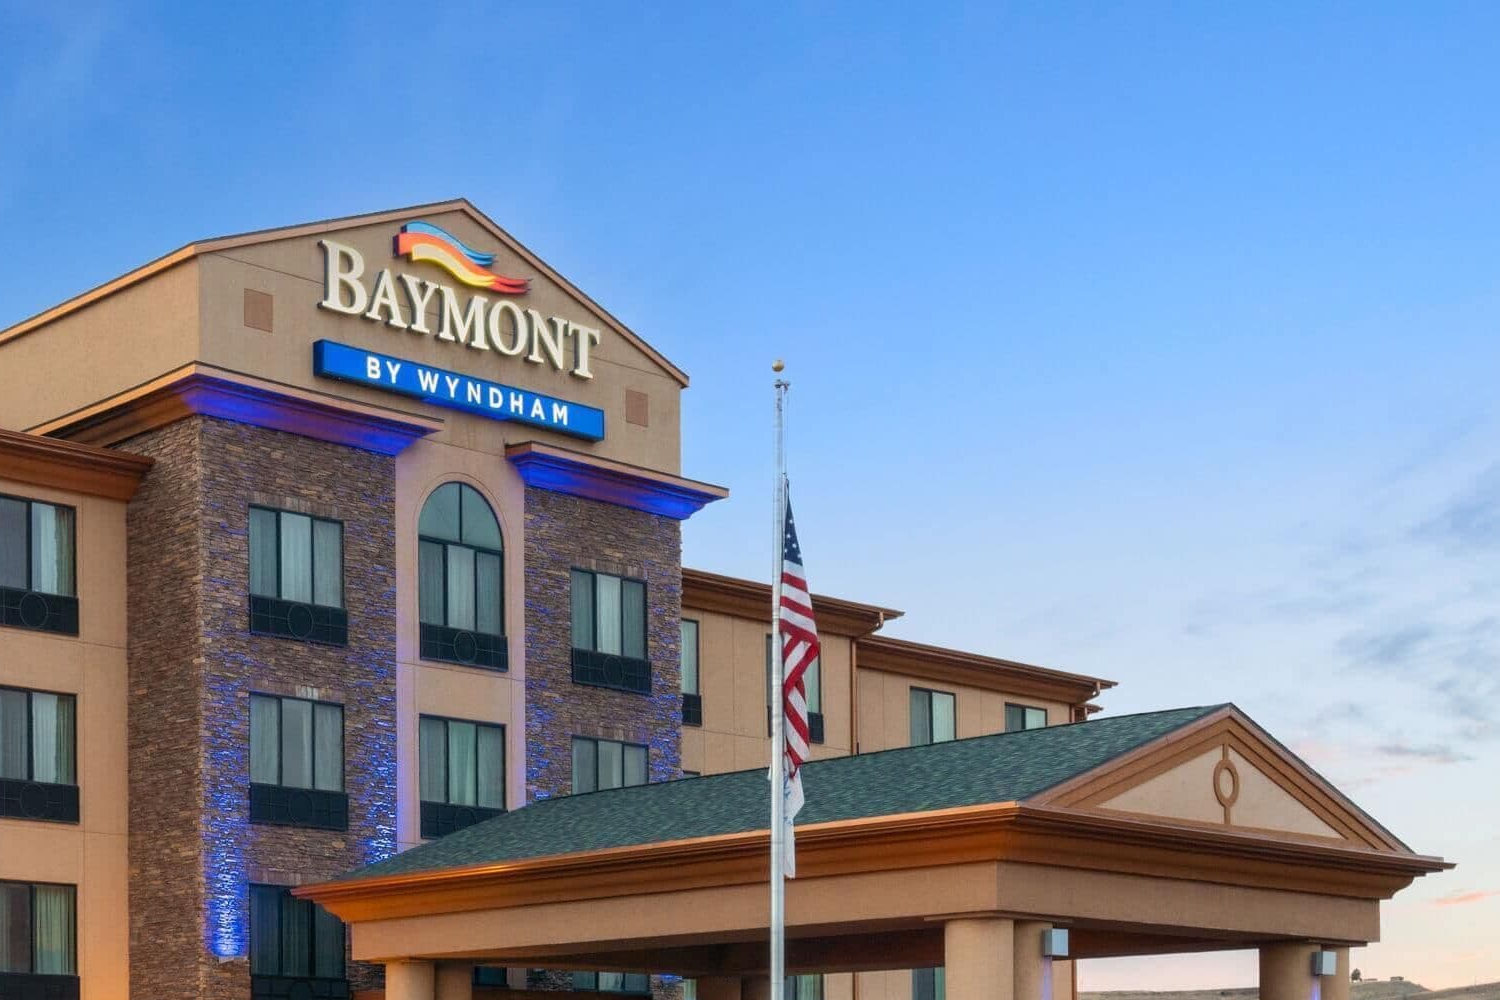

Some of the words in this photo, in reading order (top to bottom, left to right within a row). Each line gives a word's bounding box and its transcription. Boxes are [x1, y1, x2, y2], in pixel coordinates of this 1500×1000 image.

[317, 239, 600, 379] BAYMONT
[366, 355, 402, 384] BY
[417, 367, 569, 427] WYNDHAM
